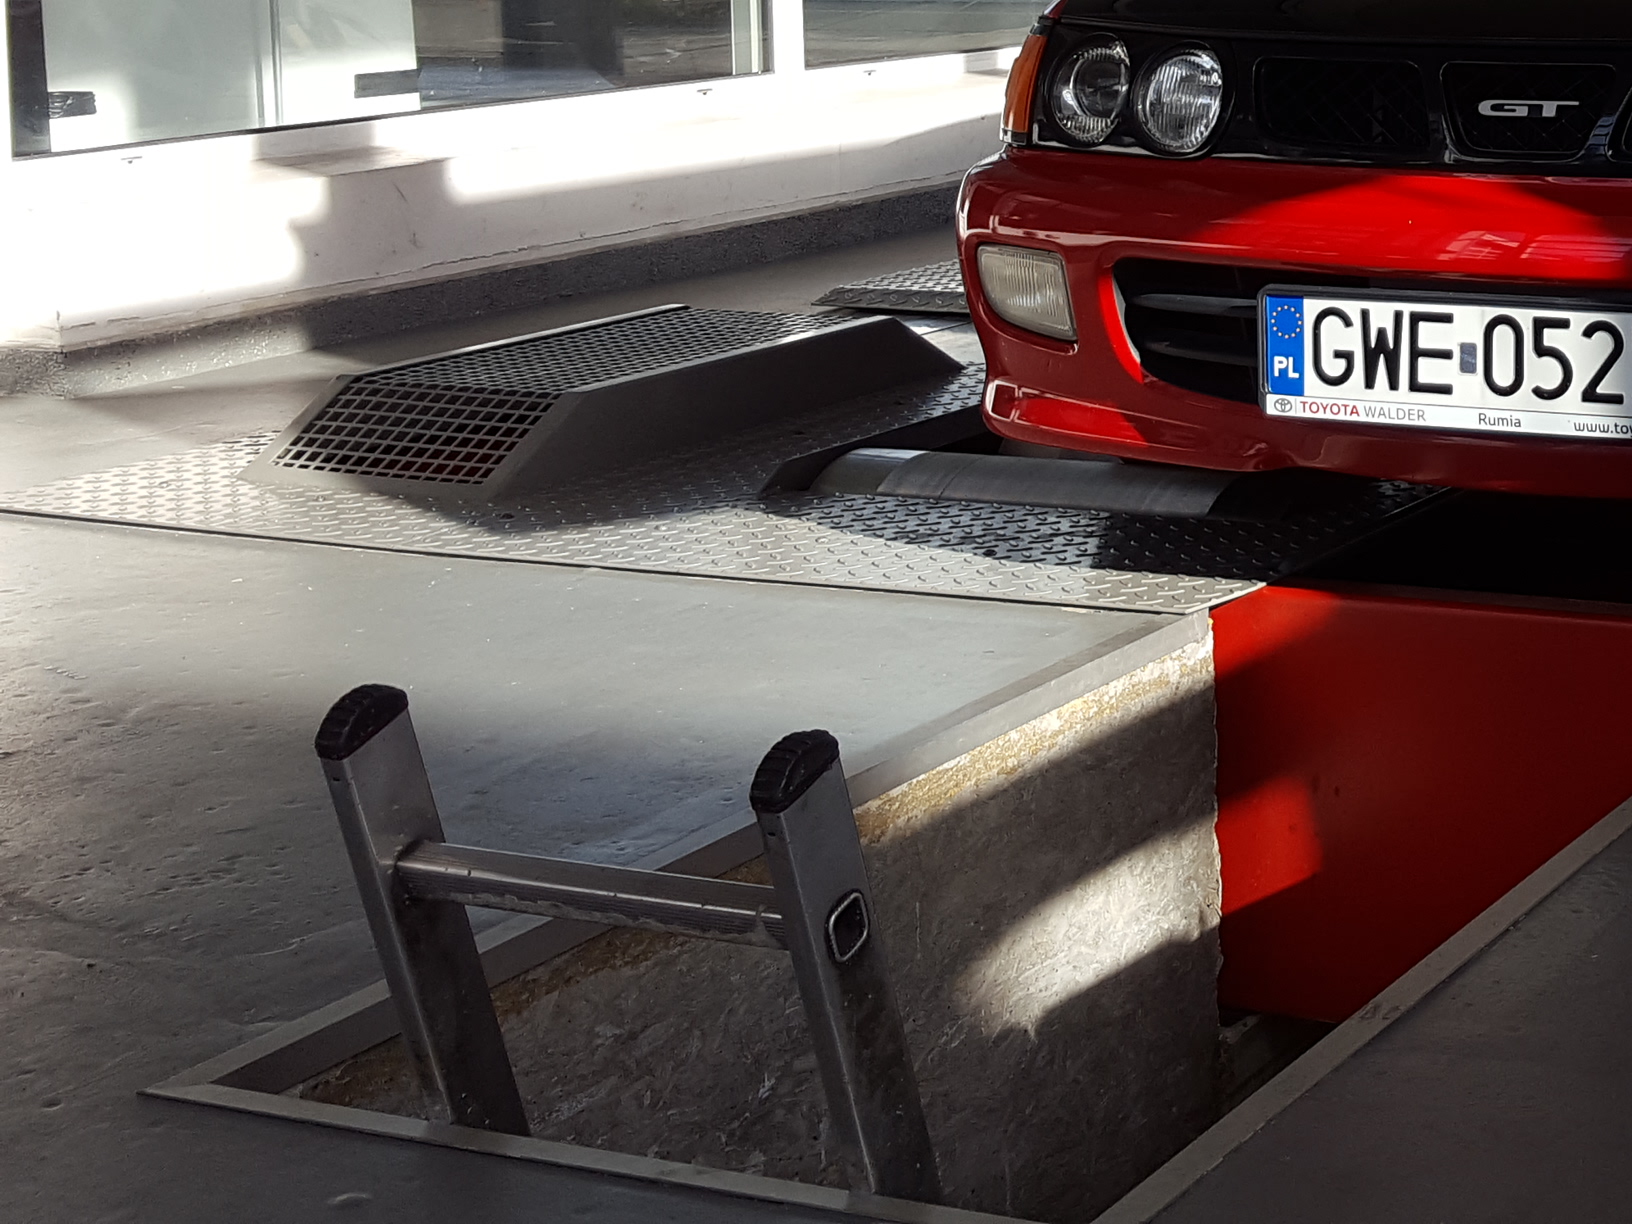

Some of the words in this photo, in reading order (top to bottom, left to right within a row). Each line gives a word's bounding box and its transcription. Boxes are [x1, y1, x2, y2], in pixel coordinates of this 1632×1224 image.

[1477, 99, 1580, 118] GT
[1311, 305, 1454, 395] GWE
[1273, 355, 1299, 379] PL
[1299, 400, 1360, 418] TOYOTA
[1363, 403, 1426, 422] WALDER
[1478, 412, 1522, 428] Rumia
